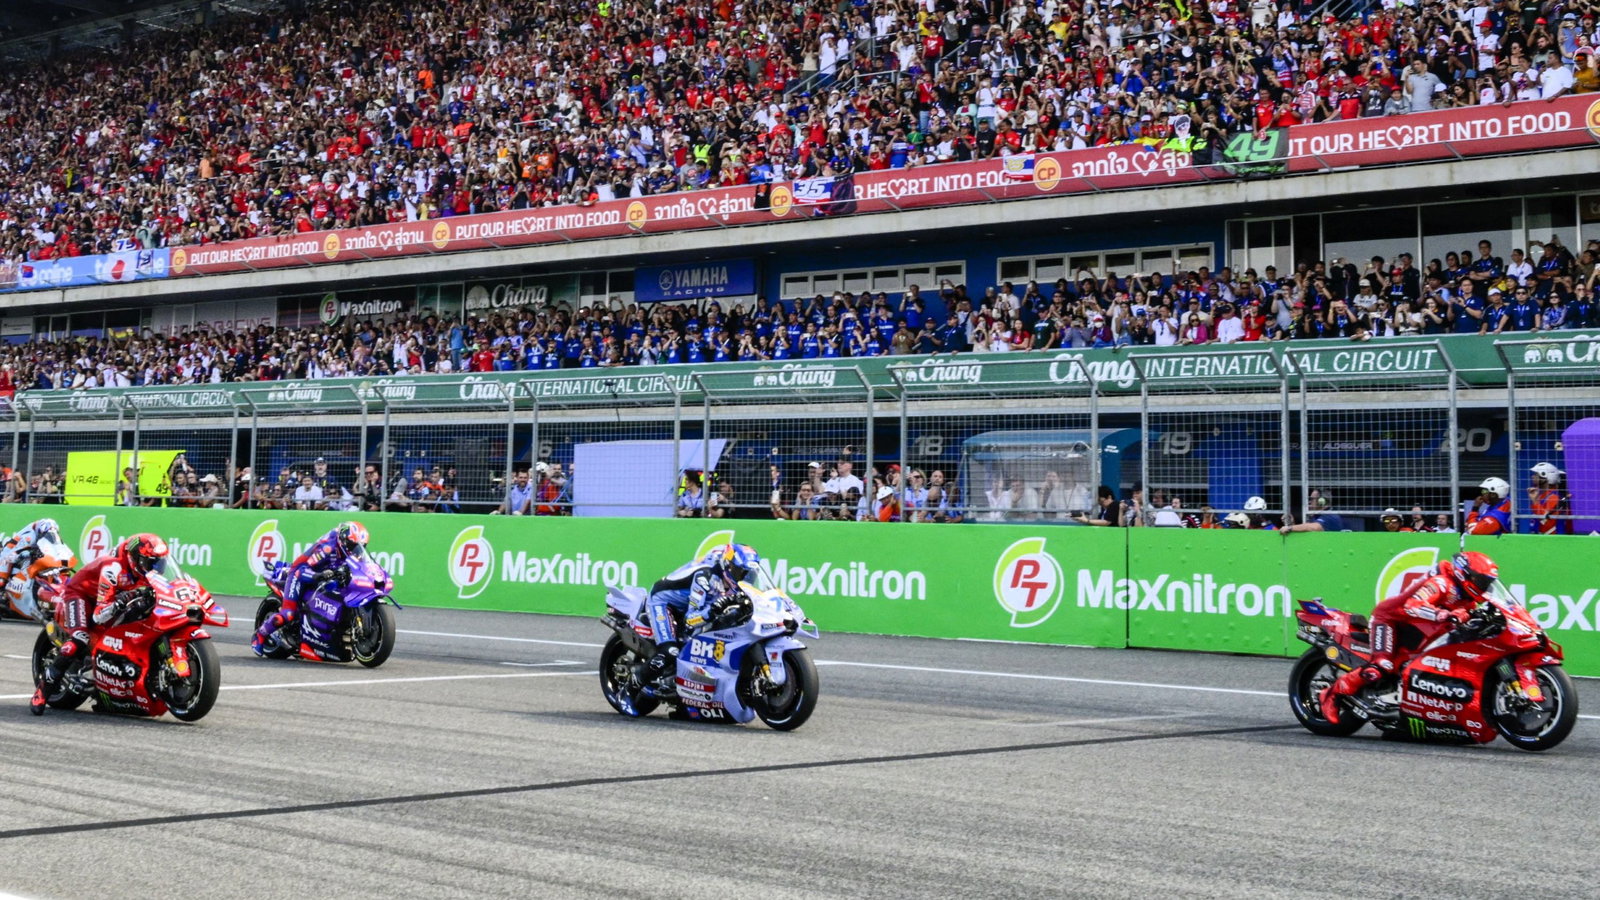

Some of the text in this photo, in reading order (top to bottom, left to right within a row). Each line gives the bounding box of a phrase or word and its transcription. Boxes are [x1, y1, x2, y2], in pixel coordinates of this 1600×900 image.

[1311, 134, 1353, 153] OUR
[1449, 118, 1501, 141] INTO
[1508, 111, 1571, 135] FOOD
[1224, 131, 1279, 162] 49
[1072, 151, 1128, 177] จากใจ
[796, 181, 825, 197] 35
[934, 174, 972, 192] INTO
[977, 170, 1021, 187] FOO
[654, 198, 695, 219] จากใจ
[456, 224, 480, 239] PUT
[480, 222, 504, 237] OUR
[555, 213, 584, 229] INTO
[586, 210, 620, 226] FOOD
[191, 252, 208, 265] PUT
[209, 250, 229, 263] OUR
[268, 244, 290, 258] INTO
[292, 241, 319, 255] FOOD
[675, 266, 728, 287] YAMAHA
[491, 283, 548, 309] Chang
[340, 299, 402, 317] Maxnitron
[779, 364, 836, 387] Chang
[918, 359, 982, 384] Chang
[1049, 348, 1437, 388] Chang INTERNATIONAL CIRCUIT
[460, 375, 515, 403] Chang
[637, 374, 702, 393] CIRCUIT
[915, 435, 944, 456] 18
[1158, 432, 1194, 455] 19
[1441, 428, 1492, 452] 20
[88, 530, 105, 558] PT
[459, 543, 484, 583] PT
[501, 550, 638, 588] Maxnitron
[1010, 559, 1048, 607] PT
[1077, 569, 1291, 618] Maxnitron
[315, 598, 337, 615] prima
[690, 639, 725, 661] BK8
[96, 654, 135, 677] Lenovo
[1421, 656, 1450, 671] GIVI
[1412, 675, 1466, 698] Lenovo
[682, 698, 709, 709] FEDERAL
[1419, 695, 1463, 711] NetApp
[1426, 711, 1456, 721] elica
